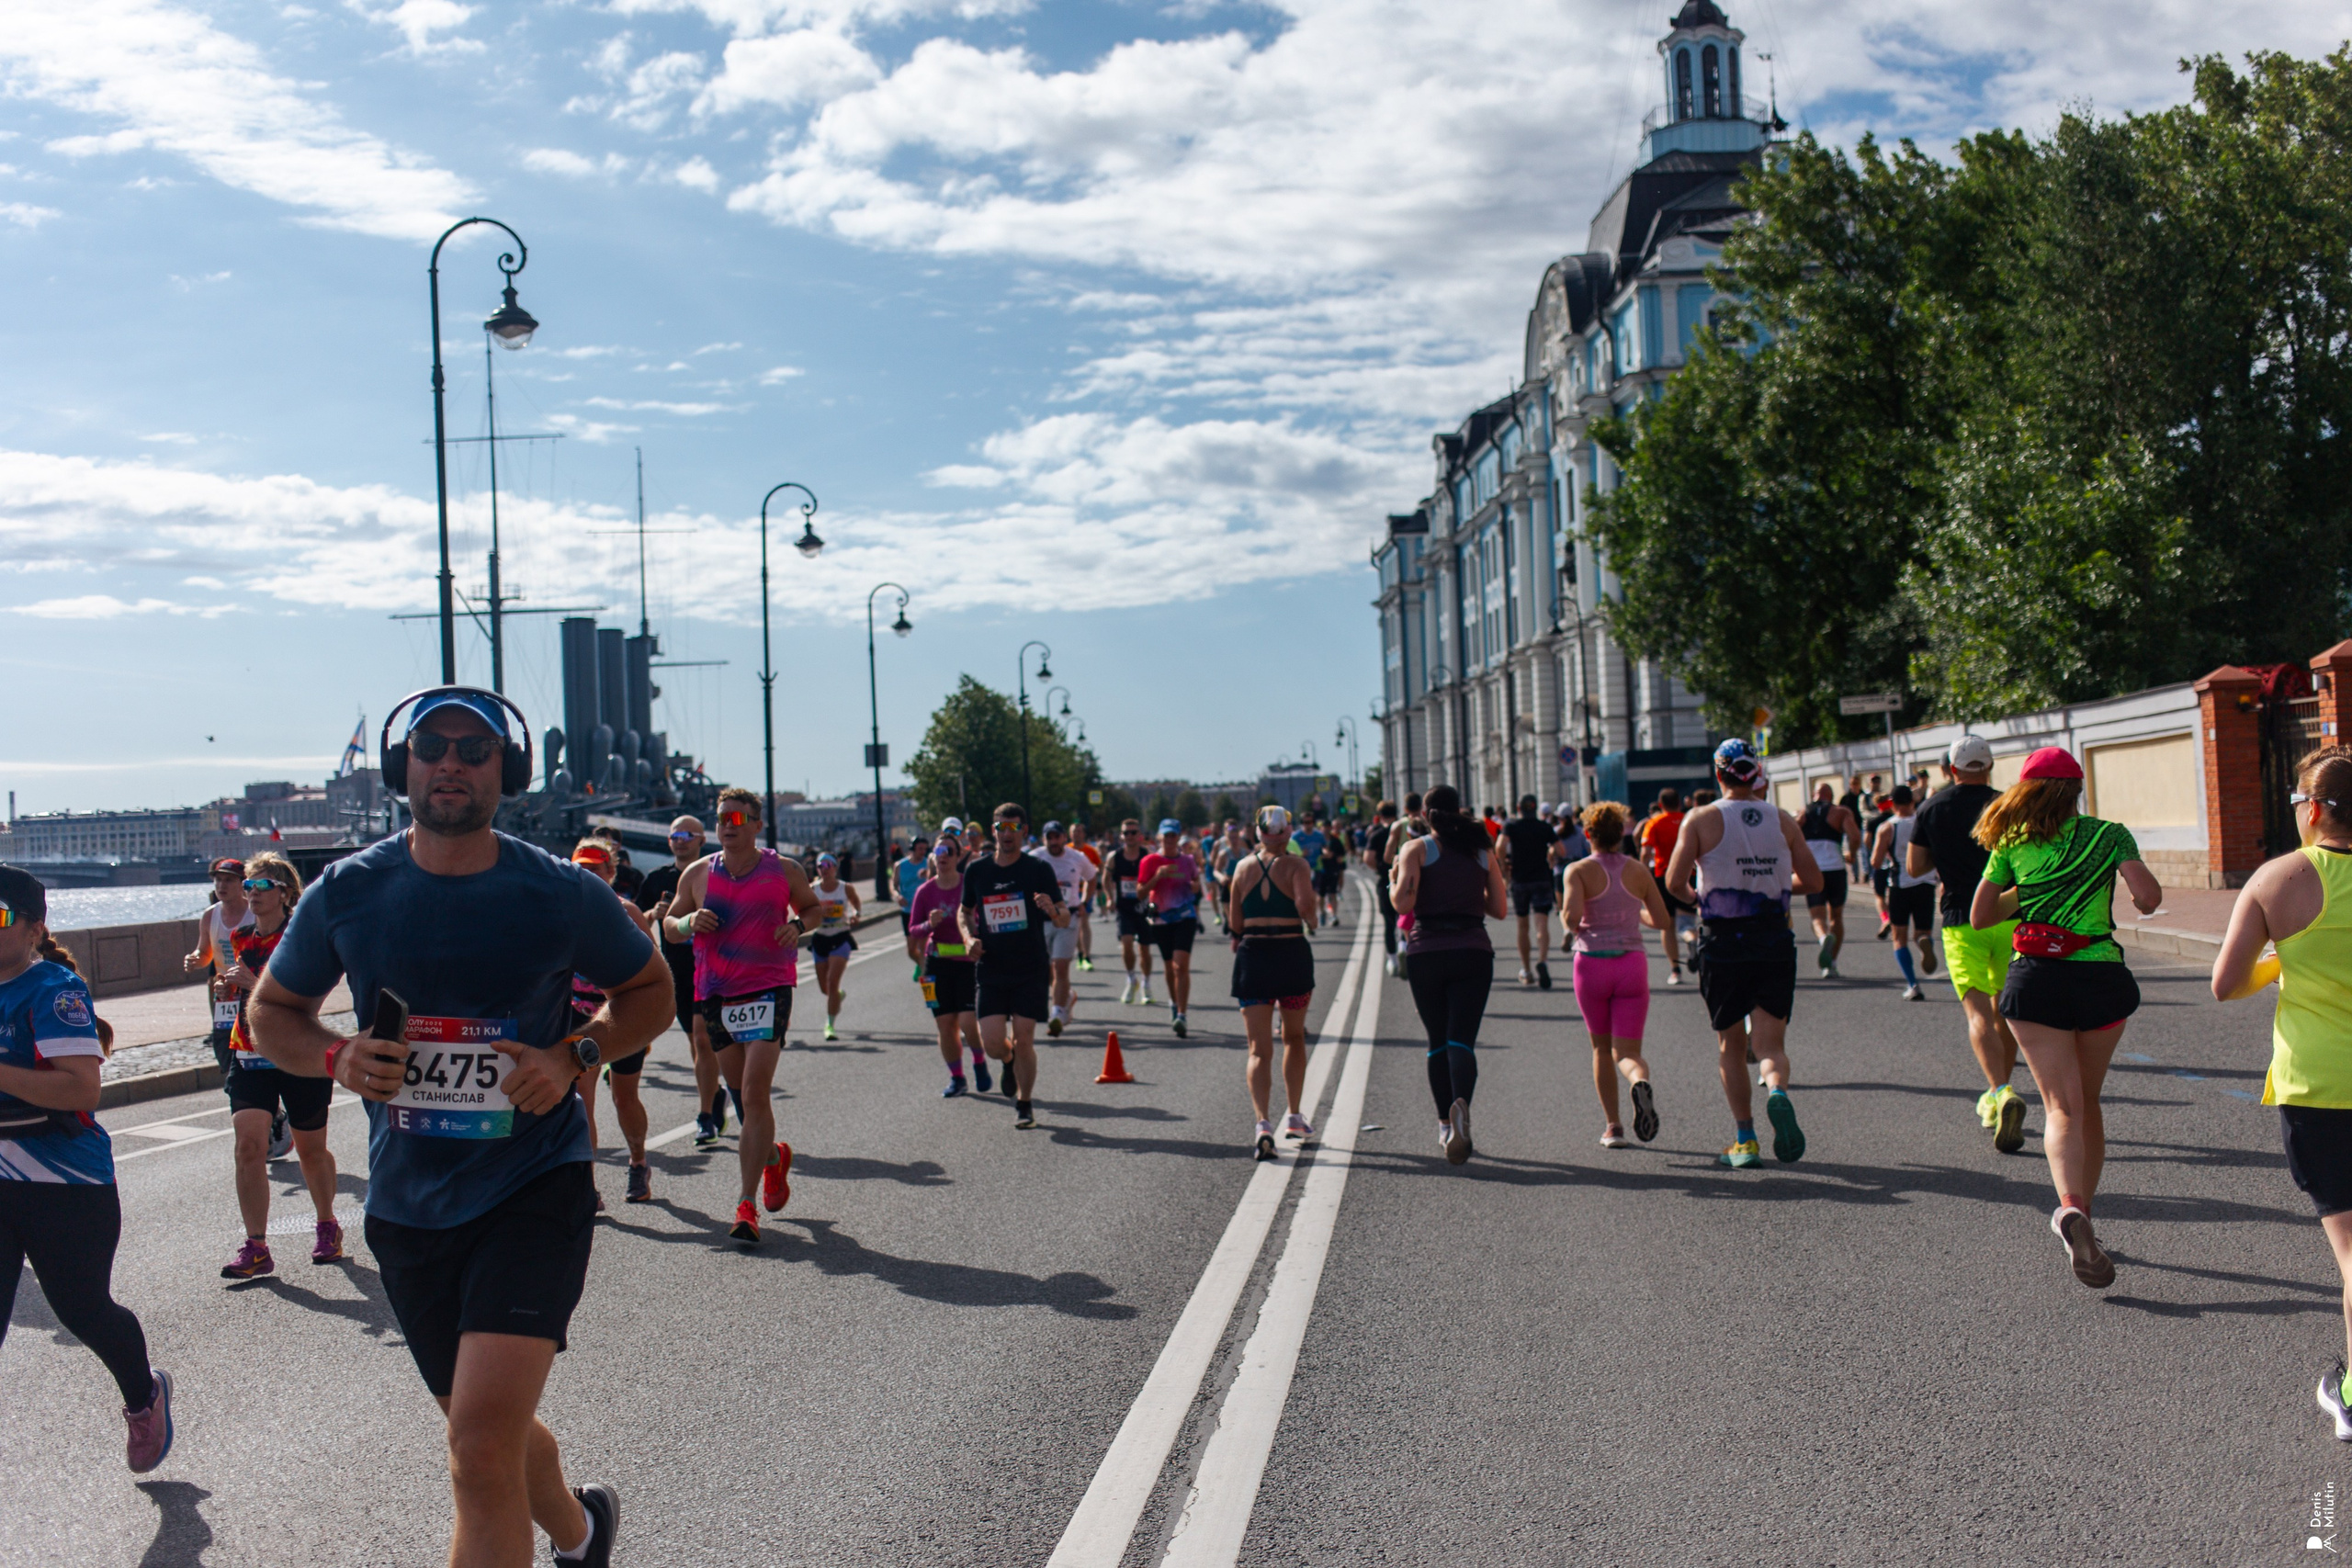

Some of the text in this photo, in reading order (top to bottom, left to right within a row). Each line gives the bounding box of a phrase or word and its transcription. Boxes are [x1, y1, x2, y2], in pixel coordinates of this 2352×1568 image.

[1736, 855, 1779, 865] run beer
[1742, 867, 1773, 877] repeat
[989, 905, 1021, 920] 7591
[729, 1005, 768, 1023] 6617
[461, 1026, 502, 1036] 21,1 КМ
[403, 1051, 499, 1089] 6475
[412, 1090, 485, 1103] СТАНИСЛАВ
[398, 1110, 411, 1130] E
